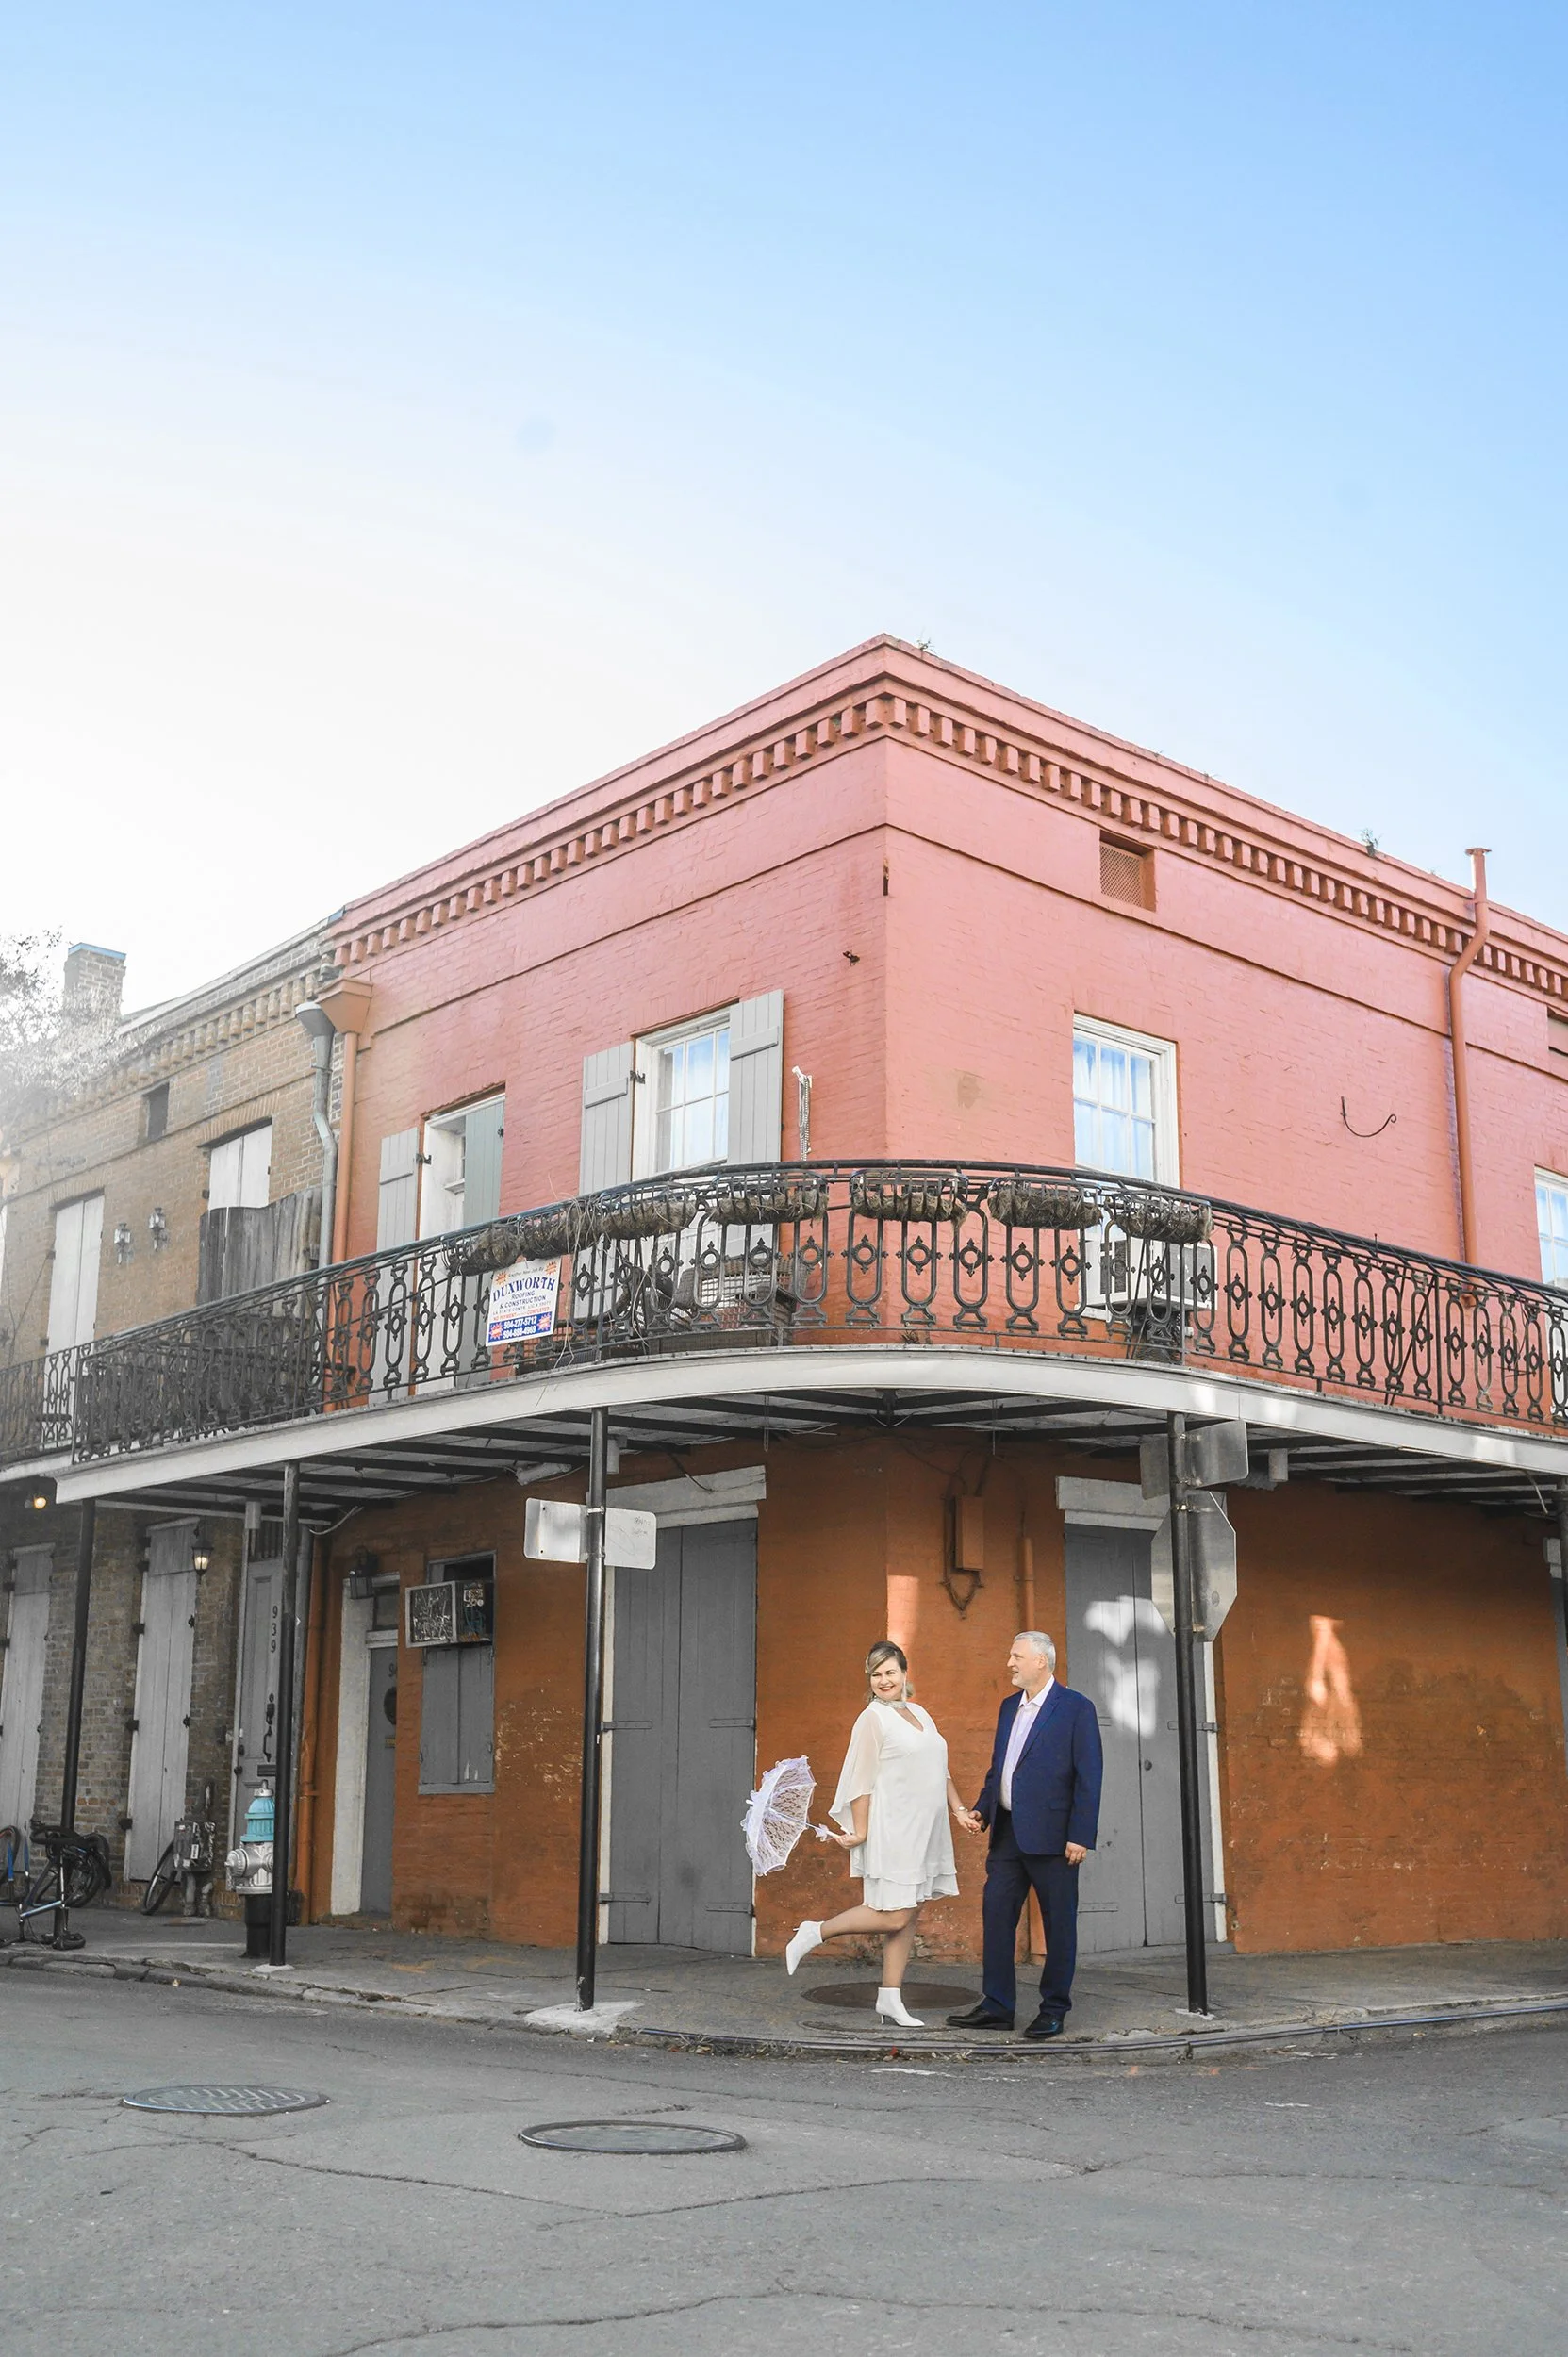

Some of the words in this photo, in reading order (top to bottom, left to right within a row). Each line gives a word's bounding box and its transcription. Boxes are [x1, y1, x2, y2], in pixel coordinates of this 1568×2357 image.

[493, 1277, 555, 1302] DUXWORTH
[511, 1291, 536, 1299] ROOFING
[504, 1295, 546, 1309] CONSTRUCTION
